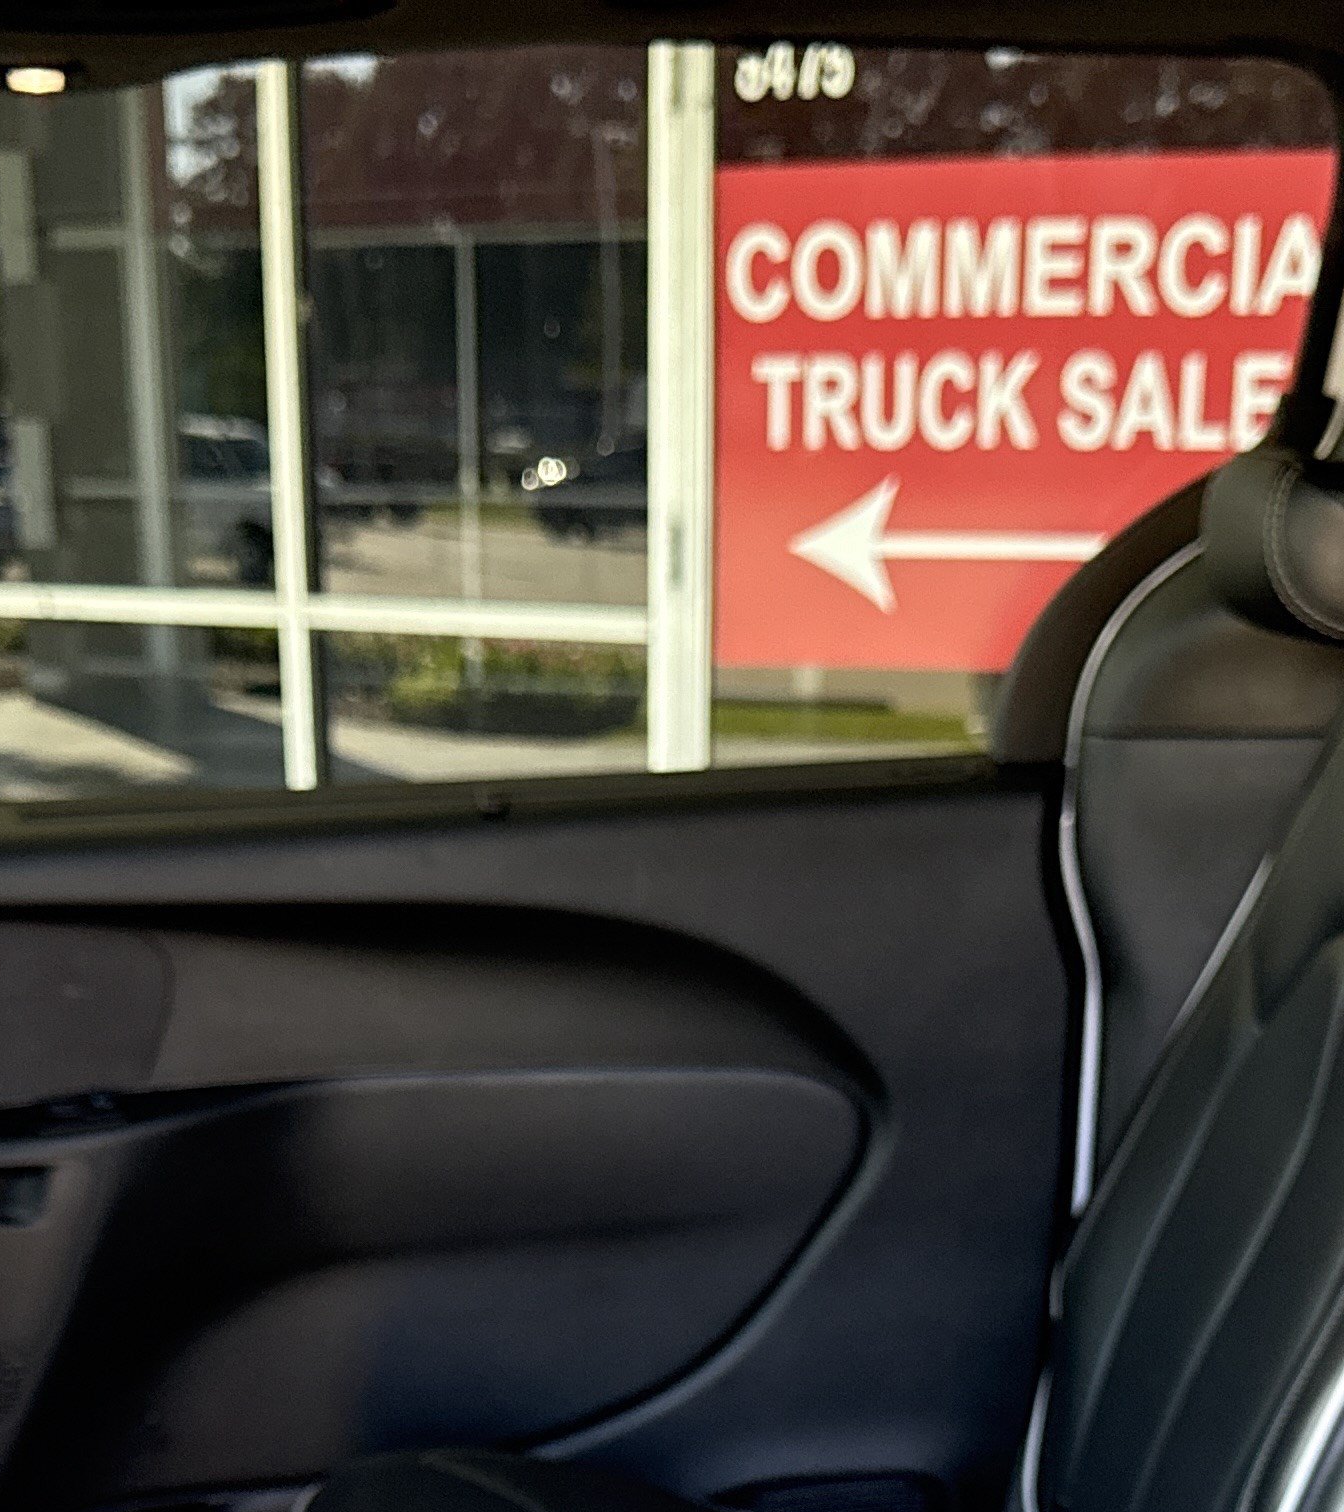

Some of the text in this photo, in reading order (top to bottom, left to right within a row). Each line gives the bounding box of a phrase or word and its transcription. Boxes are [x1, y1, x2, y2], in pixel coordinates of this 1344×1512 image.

[725, 212, 1322, 323] COMMERCIA
[751, 349, 1294, 452] TRUCK SALE
